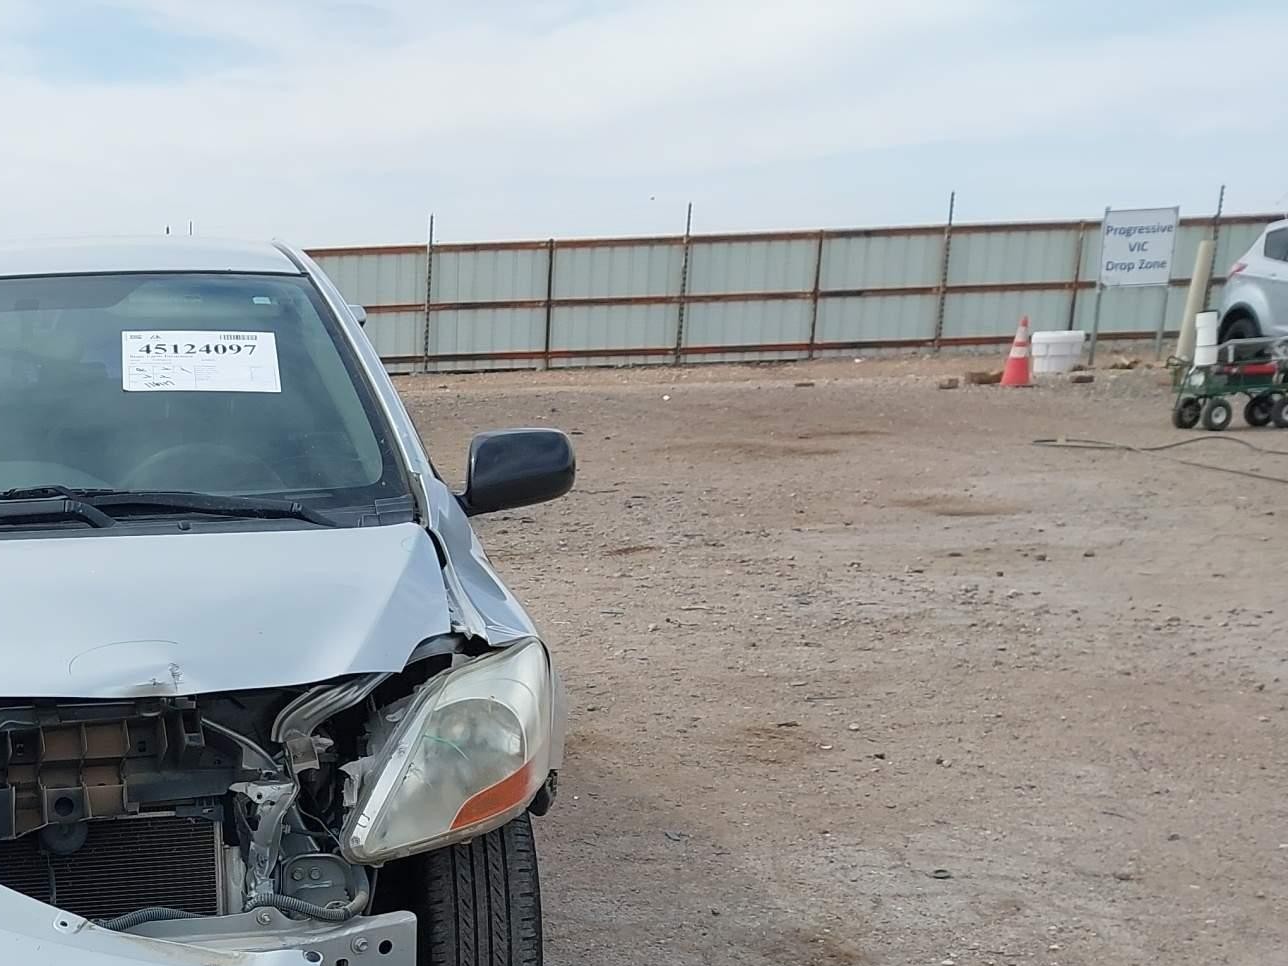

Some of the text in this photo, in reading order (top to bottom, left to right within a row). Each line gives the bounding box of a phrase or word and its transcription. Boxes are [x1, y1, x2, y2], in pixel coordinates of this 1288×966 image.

[1105, 223, 1174, 237] Progressive
[1128, 241, 1150, 252] VIC
[1105, 259, 1168, 272] Drop Zone
[138, 343, 257, 355] 45124097
